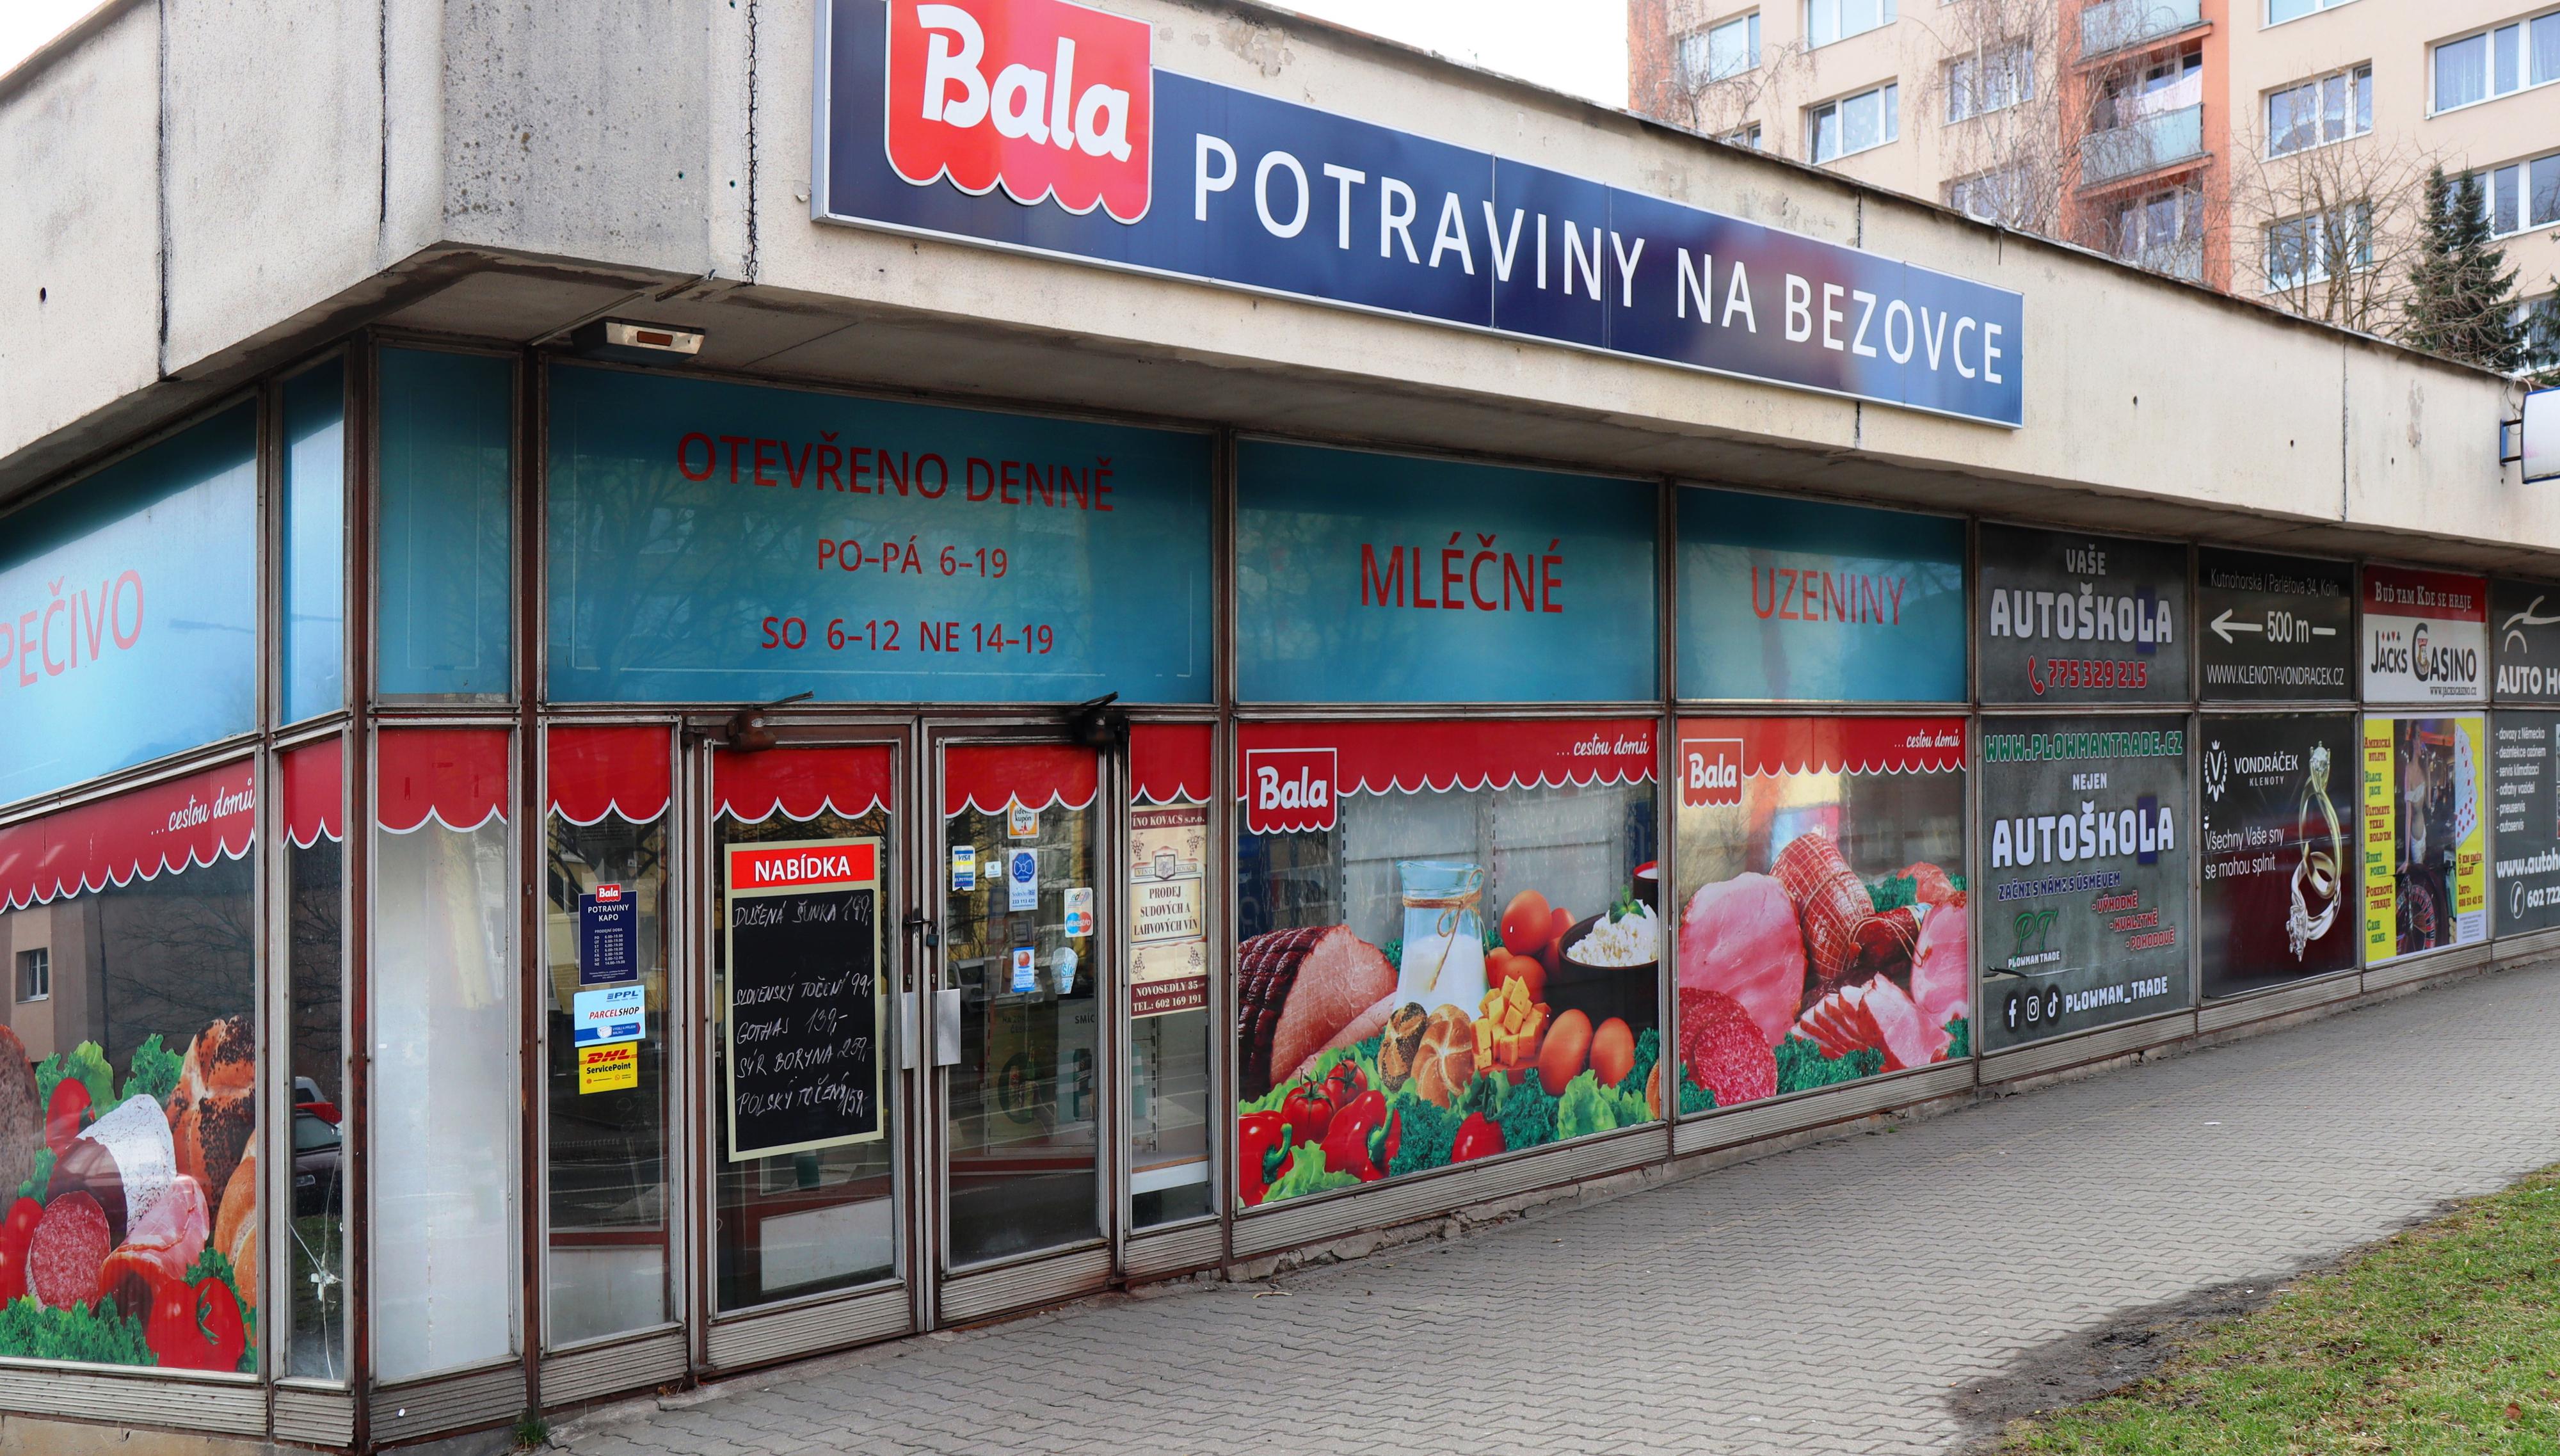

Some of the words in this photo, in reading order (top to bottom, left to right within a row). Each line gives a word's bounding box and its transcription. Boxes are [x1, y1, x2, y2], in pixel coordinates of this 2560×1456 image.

[917, 4, 1132, 162] Bala
[1195, 133, 1645, 307] POTRAVINY
[1677, 248, 1756, 334] NA
[1785, 273, 2002, 384] BEZOVCE
[677, 431, 948, 499] OTEVŘENO
[966, 457, 1114, 511] DENNĚ
[1361, 531, 1564, 613] MLÉČNÉ
[2066, 543, 2106, 575] VAŠE
[1751, 564, 1907, 625] UZENINY
[2211, 568, 2262, 591] Kutnohorská
[2307, 577, 2319, 598] 34,
[1990, 582, 2172, 643] AUTOŠKOLA
[2397, 588, 2414, 605] TAM
[2417, 586, 2435, 607] KDE
[2438, 592, 2447, 607] SE
[2449, 593, 2472, 612] HRAJE
[762, 616, 807, 650] SO
[920, 621, 959, 653] NE
[2268, 611, 2292, 643] 500
[2296, 620, 2309, 643] m
[2371, 630, 2408, 673] JACKS
[2412, 622, 2477, 682] CASINO
[2047, 659, 2080, 688] 775
[2083, 660, 2115, 688] 329
[2117, 661, 2147, 689] 215
[2207, 664, 2344, 685] WWW.KLENOTY-VONDRACEK.CZ
[2497, 665, 2542, 695] AUTO
[2547, 668, 2560, 695] H
[1613, 733, 1650, 755] domů
[1935, 728, 1961, 747] domů
[1985, 731, 2182, 762] WWW.PLOWMANTRADE.CZ
[1689, 753, 1737, 788] Bala
[2234, 751, 2298, 774] VONDRÁČEK
[1257, 766, 1328, 810] Bala
[2073, 773, 2107, 790] NEJEN
[2249, 776, 2284, 787] KLENOTY
[1150, 815, 1183, 826] KOVACS
[1992, 800, 2174, 868] AUTOŠKOLA
[2204, 828, 2243, 851] Všechny
[2245, 826, 2267, 845] Vaše
[2269, 828, 2284, 845] sny
[754, 854, 851, 882] NABÍDKA
[2205, 864, 2216, 879] se
[2219, 856, 2250, 877] mohou
[2252, 852, 2276, 877] splnit
[2497, 847, 2560, 879] www.autoh
[598, 888, 619, 898] Bala
[1149, 886, 1181, 899] PRODEJ
[1998, 878, 2031, 901] ZAČNI
[2033, 881, 2038, 897] S
[2068, 877, 2076, 893] S
[2076, 868, 2121, 893] ÚSMĚVEM
[588, 904, 630, 914] POTRAVINY
[1140, 900, 1183, 918] SUDOVÝCH
[1185, 902, 1190, 913] A
[2527, 889, 2545, 908] 602
[598, 914, 619, 922] KAPO
[732, 900, 787, 928] DUŠENÁ
[792, 899, 836, 923] ŠUNKA
[1067, 918, 1091, 927] Maestro
[1133, 918, 1181, 936] LAHVOVÝCH
[1185, 916, 1198, 930] VÍN
[2008, 954, 2039, 968] PLOWMAN
[2040, 950, 2060, 963] TRADE
[614, 990, 638, 999] PPL
[1136, 981, 1186, 997] NOVOSEDLY
[1188, 980, 1198, 990] 35
[2065, 976, 2168, 1013] PLOWMAN_TRADE
[589, 1006, 639, 1020] PARCELSHOP
[1133, 1002, 1153, 1012] TEL.:
[1155, 998, 1170, 1009] 602
[1172, 996, 1186, 1006] 169
[1189, 994, 1201, 1004] 191
[586, 1062, 631, 1075] ServicePoint
[587, 1049, 630, 1064] DHL
[737, 1048, 767, 1078] SÝR
[774, 1043, 833, 1073] BORYNA
[737, 1079, 794, 1116] POLSKÝ
